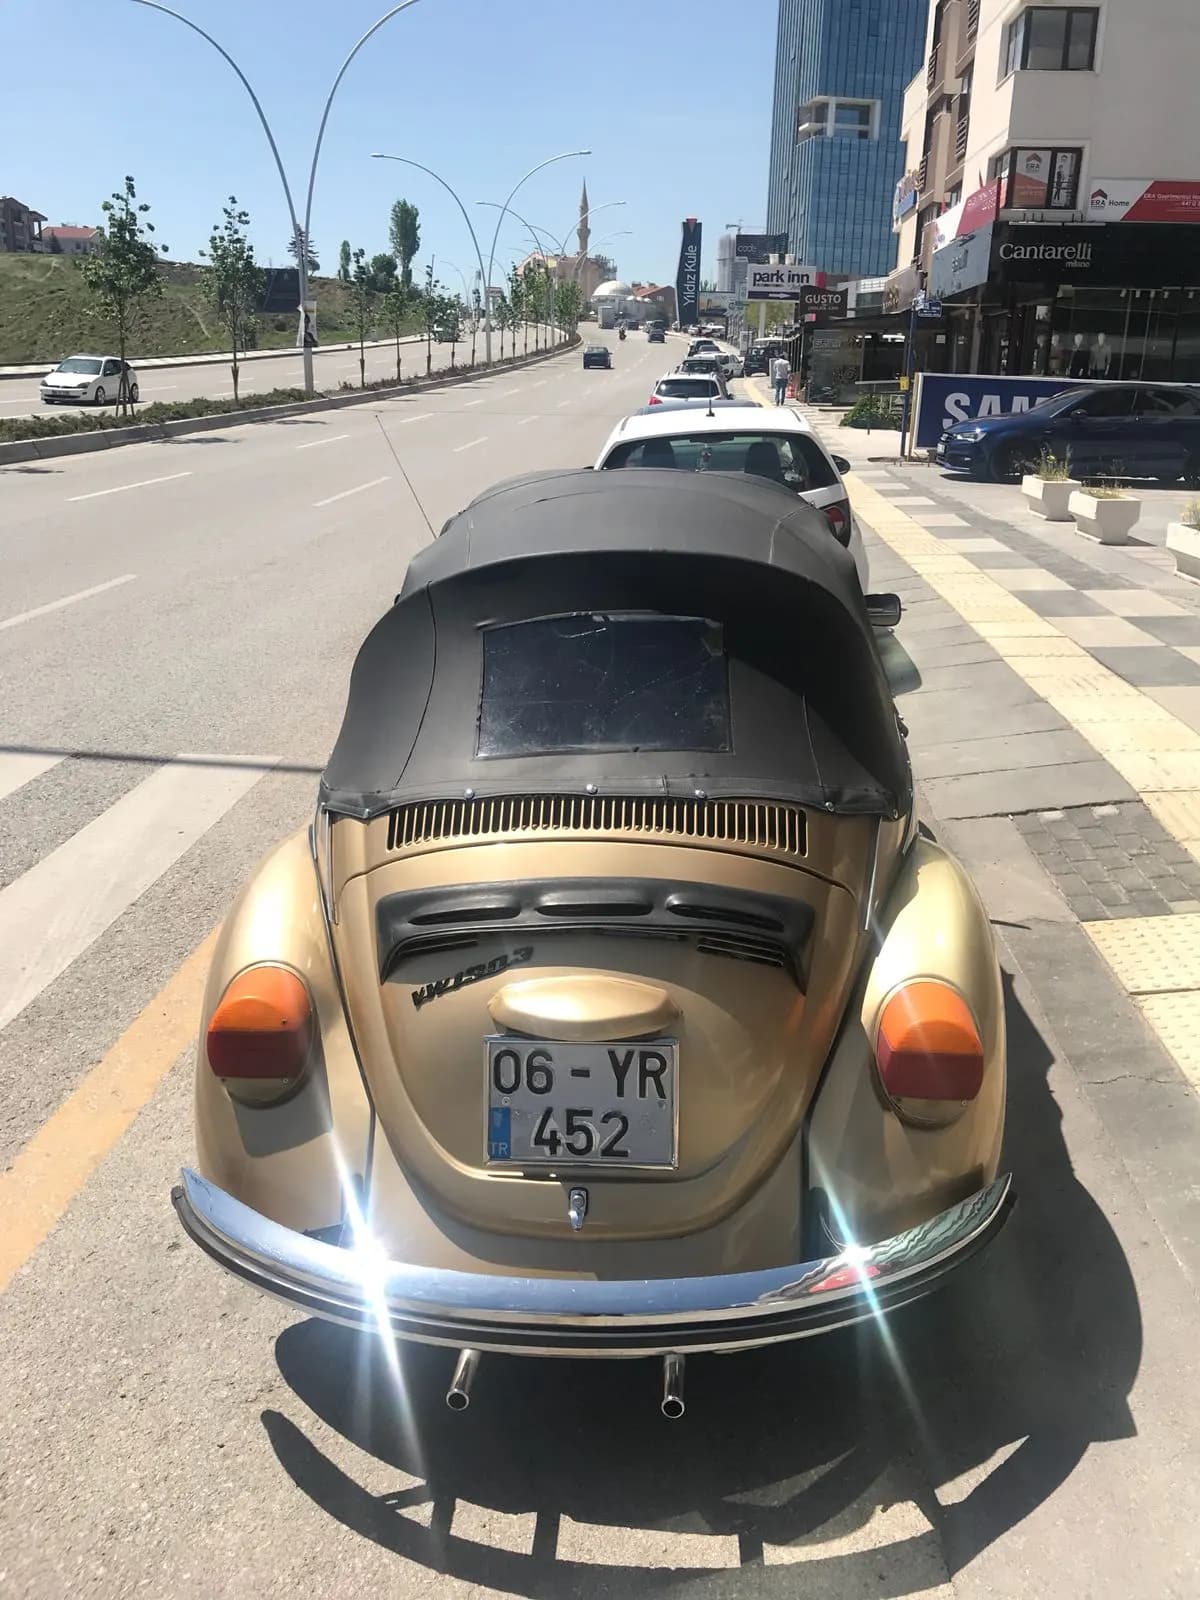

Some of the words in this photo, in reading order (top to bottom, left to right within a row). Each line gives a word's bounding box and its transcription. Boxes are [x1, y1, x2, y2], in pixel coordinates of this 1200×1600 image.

[1091, 200, 1106, 208] ERA
[684, 245, 697, 271] Kule
[999, 242, 1092, 260] Cantarelli
[752, 270, 785, 287] park
[787, 270, 810, 284] inn
[804, 294, 842, 304] GUSTO
[493, 1049, 554, 1095] 06
[607, 1049, 668, 1100] YR
[533, 1106, 630, 1158] 452
[490, 1142, 509, 1155] TR
